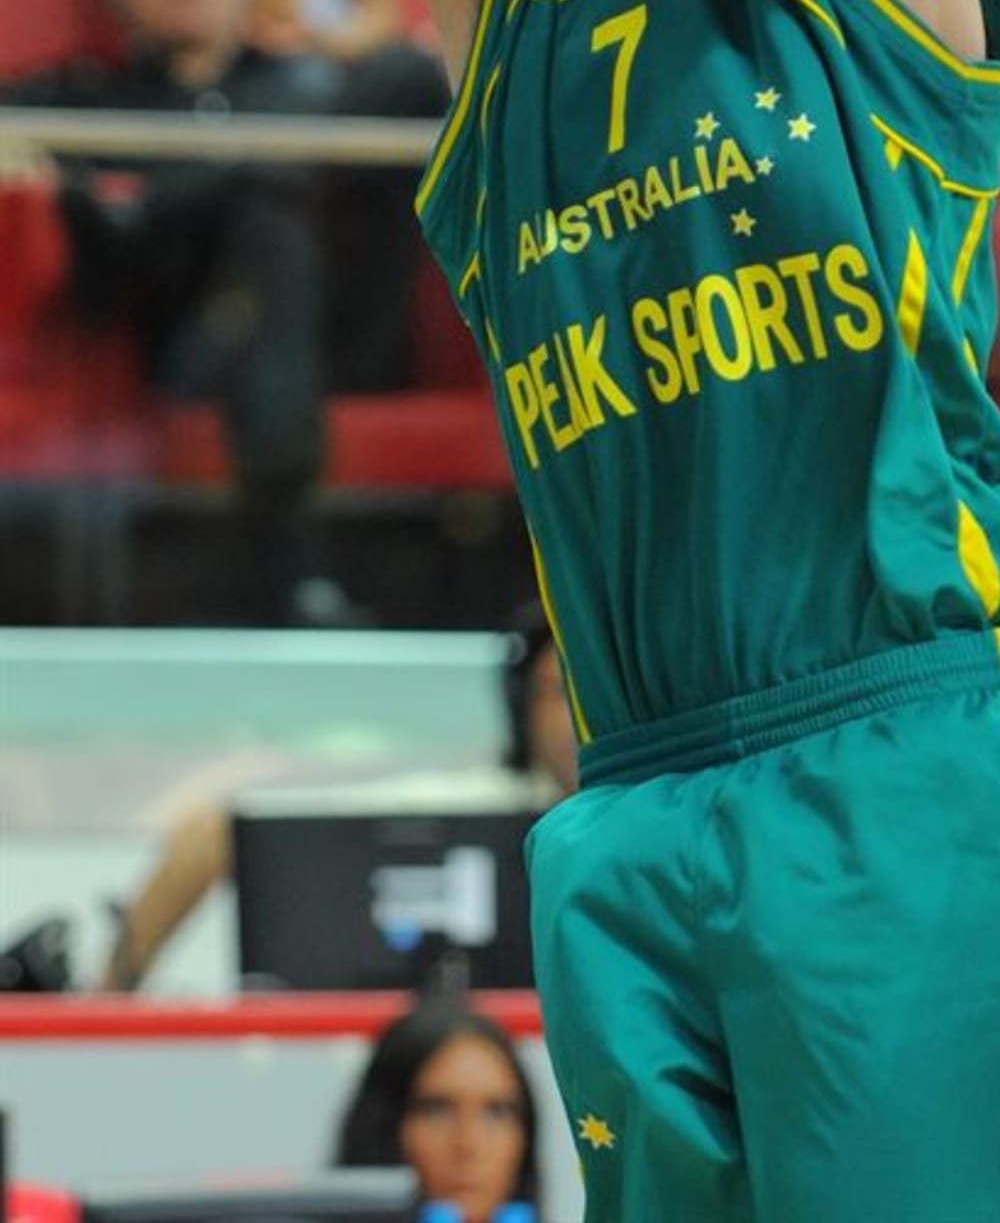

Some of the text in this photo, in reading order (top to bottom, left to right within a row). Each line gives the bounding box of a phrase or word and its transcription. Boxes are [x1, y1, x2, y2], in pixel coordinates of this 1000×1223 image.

[590, 4, 647, 154] 7
[516, 137, 757, 274] AUSTRALIA
[505, 243, 884, 470] PEAK SPORTS
